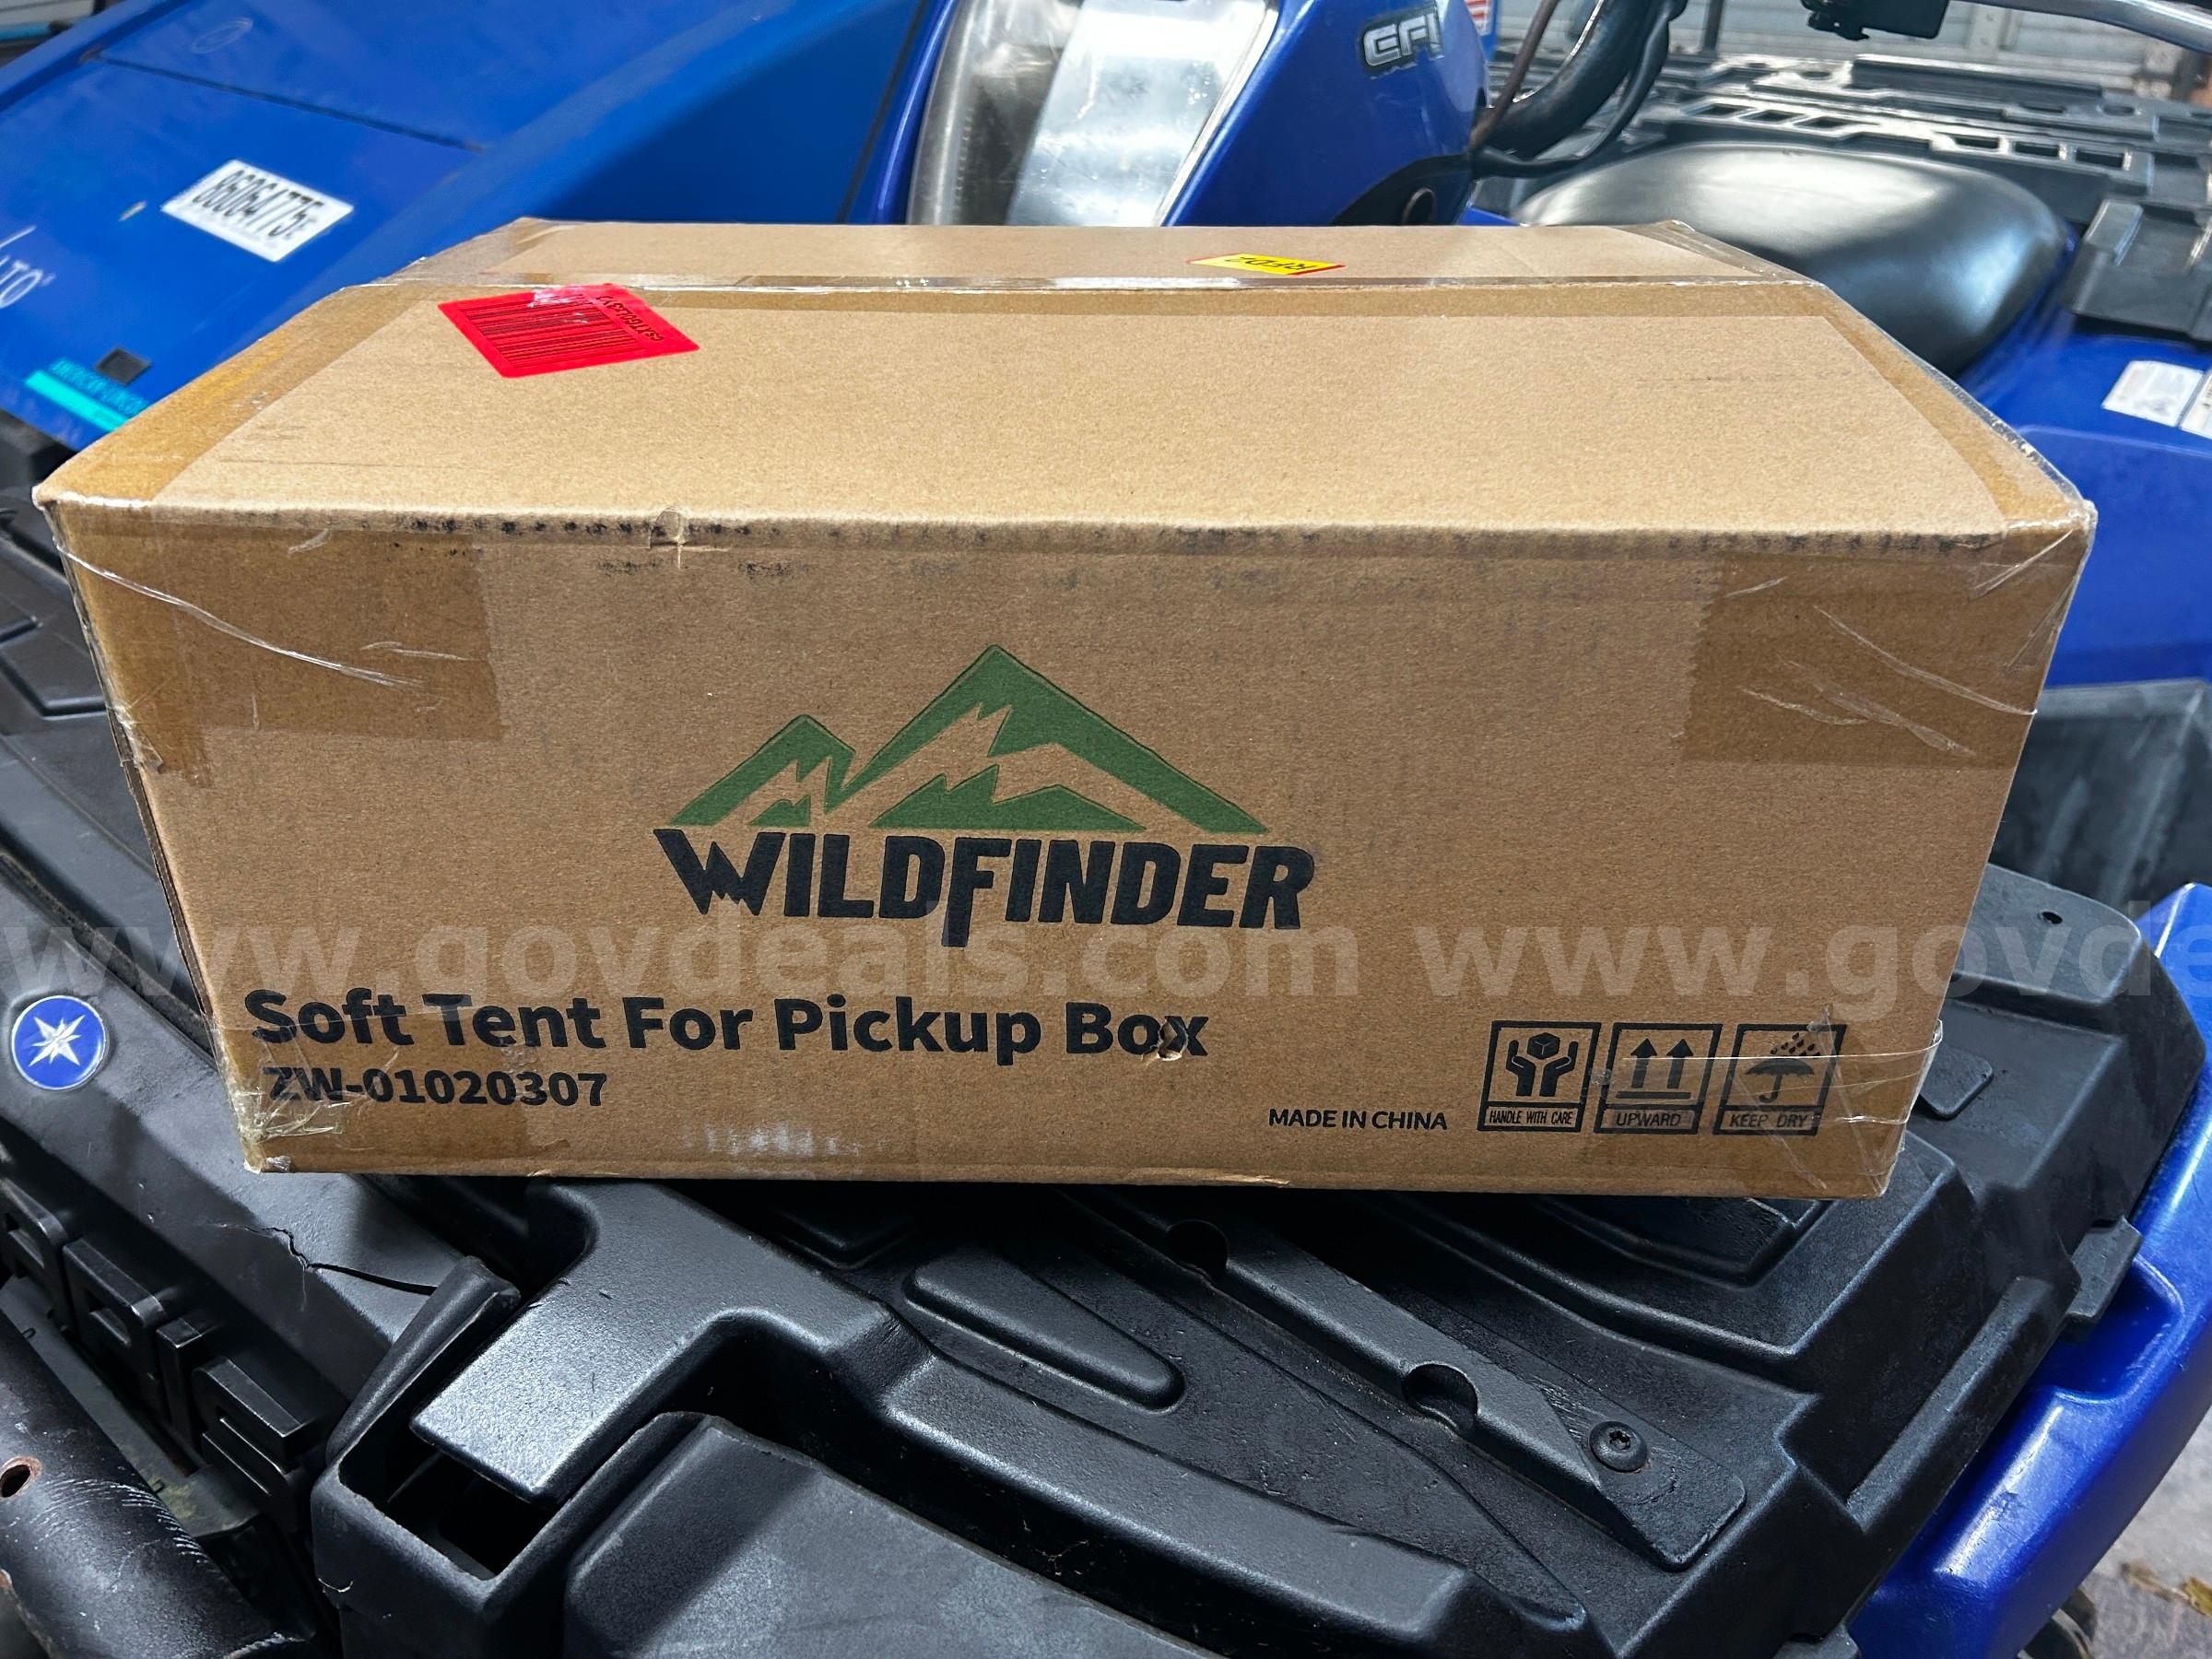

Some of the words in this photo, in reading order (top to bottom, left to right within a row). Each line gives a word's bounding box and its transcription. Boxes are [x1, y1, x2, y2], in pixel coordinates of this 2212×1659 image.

[1364, 12, 1441, 66] EFI
[653, 829, 1315, 947] WILDFINDER
[244, 987, 415, 1046] Soft
[422, 993, 606, 1049] Tent
[622, 995, 754, 1051] For
[774, 994, 1042, 1066] Pickup
[1065, 1002, 1209, 1057] Box
[263, 1066, 607, 1107] ZW-01020307
[1268, 1109, 1337, 1128] MADE
[1342, 1110, 1366, 1129] IN
[1371, 1111, 1448, 1131] CHINA
[1488, 1110, 1524, 1124] HANDLE
[1525, 1111, 1548, 1124] WITH
[1551, 1111, 1573, 1125] CARE
[1616, 1112, 1681, 1127] UPWARD
[1729, 1112, 1770, 1128] KEEP
[1776, 1113, 1808, 1128] DRY
